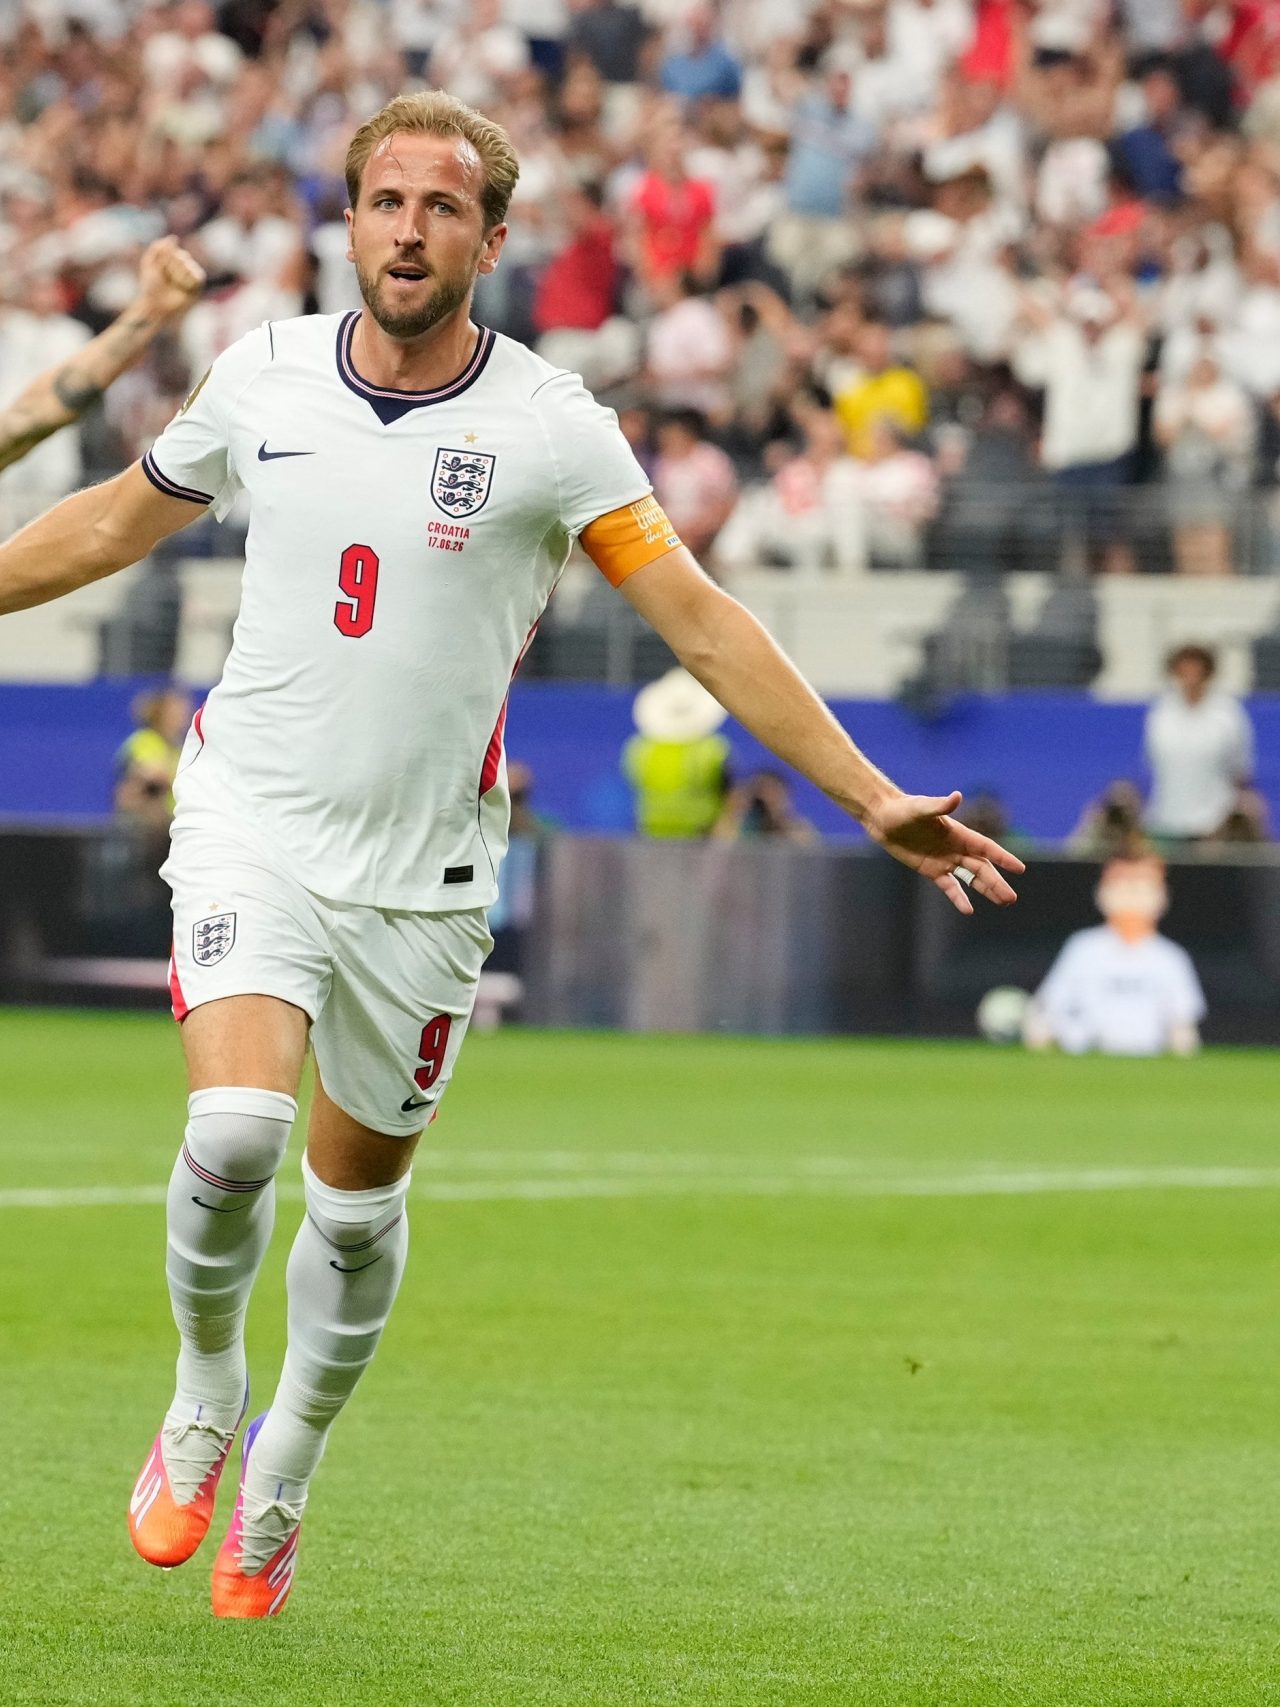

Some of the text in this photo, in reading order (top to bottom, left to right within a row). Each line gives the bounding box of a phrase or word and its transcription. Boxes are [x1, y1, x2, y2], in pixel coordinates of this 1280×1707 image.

[427, 520, 470, 539] CROATIA
[428, 536, 465, 552] 17.06.26
[333, 543, 380, 639] 9
[414, 1013, 452, 1091] 9
